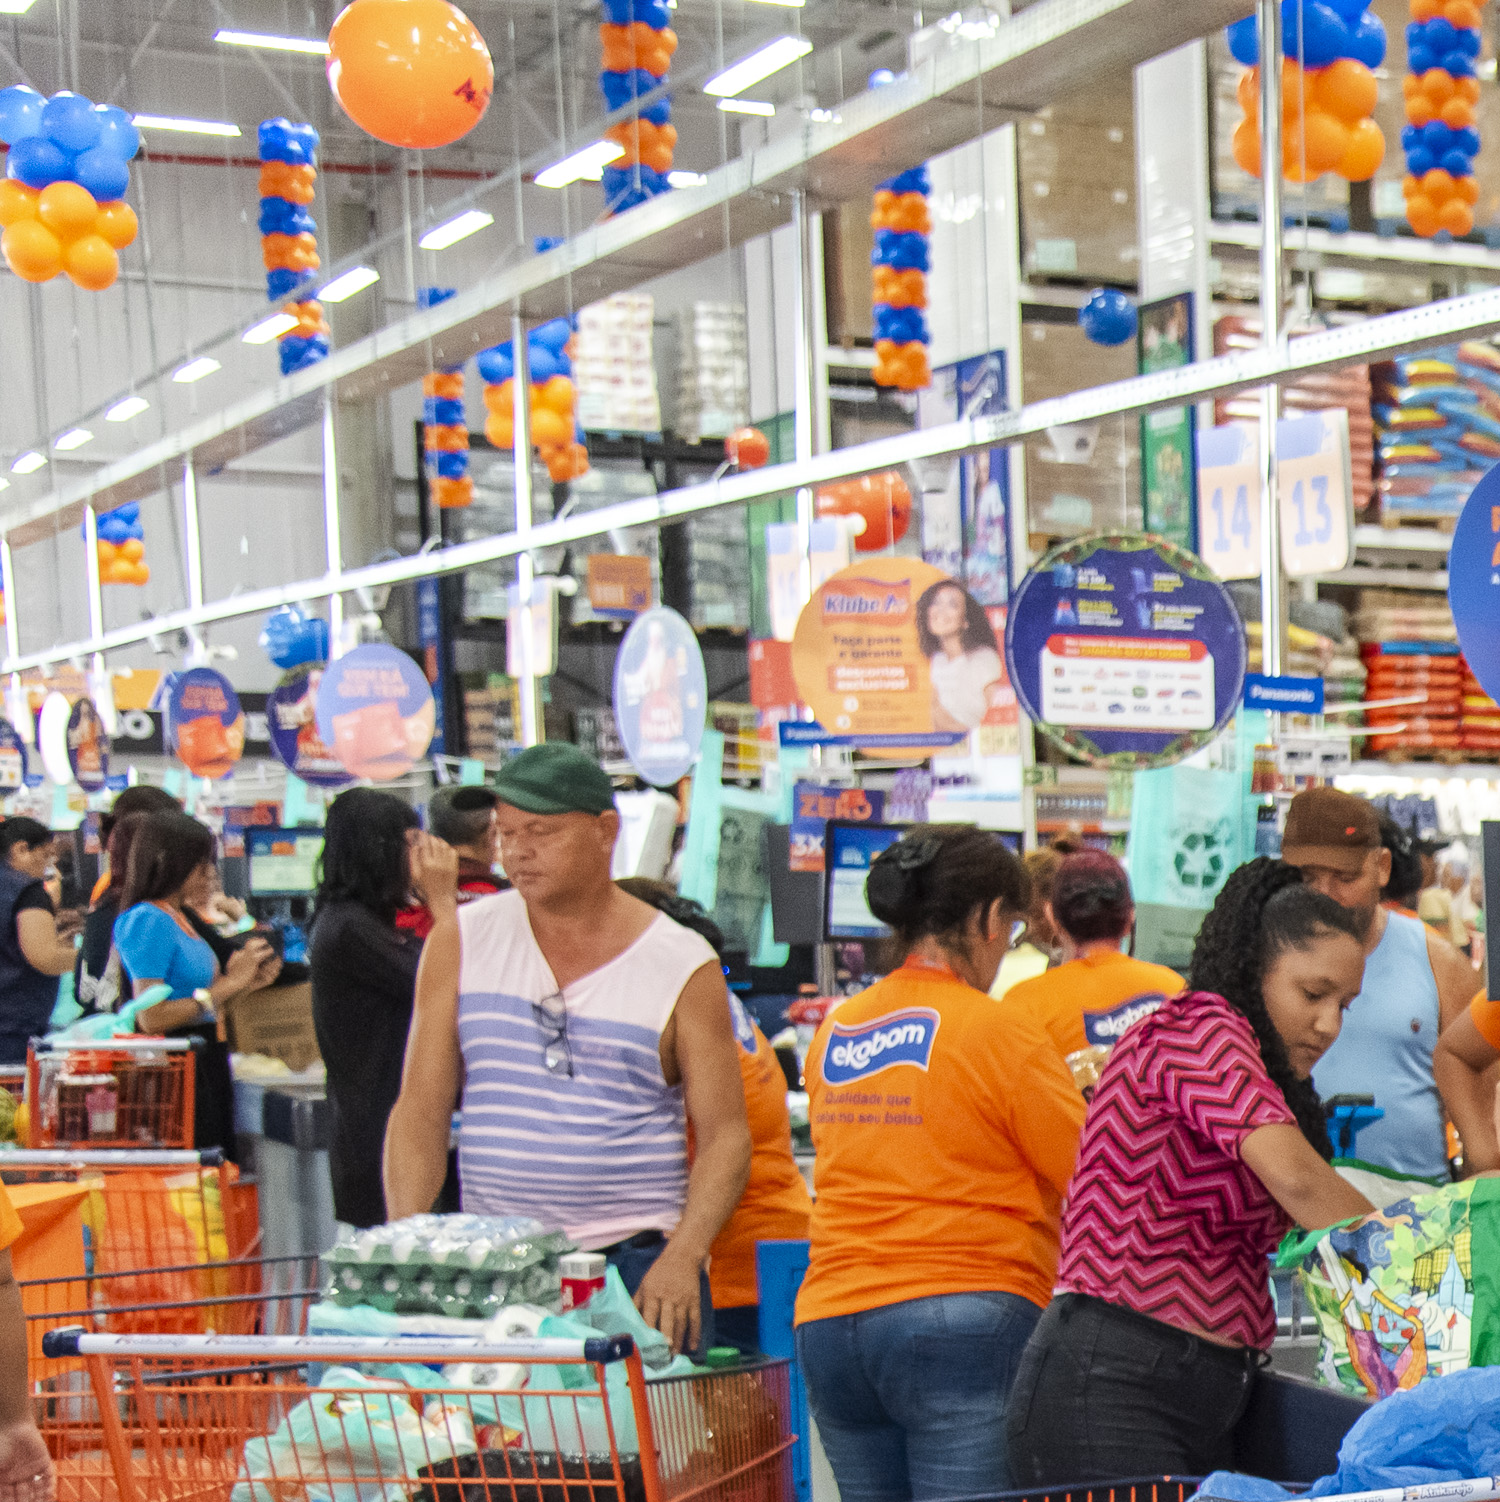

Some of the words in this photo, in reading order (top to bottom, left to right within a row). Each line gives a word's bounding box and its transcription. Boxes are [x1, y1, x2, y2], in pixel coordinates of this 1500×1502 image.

[1211, 487, 1251, 552] 14
[1292, 476, 1333, 545] 13
[824, 594, 879, 614] Klube
[791, 833, 825, 858] 3X
[831, 1024, 924, 1067] ekobom
[1419, 1483, 1474, 1499] Atakarejo
